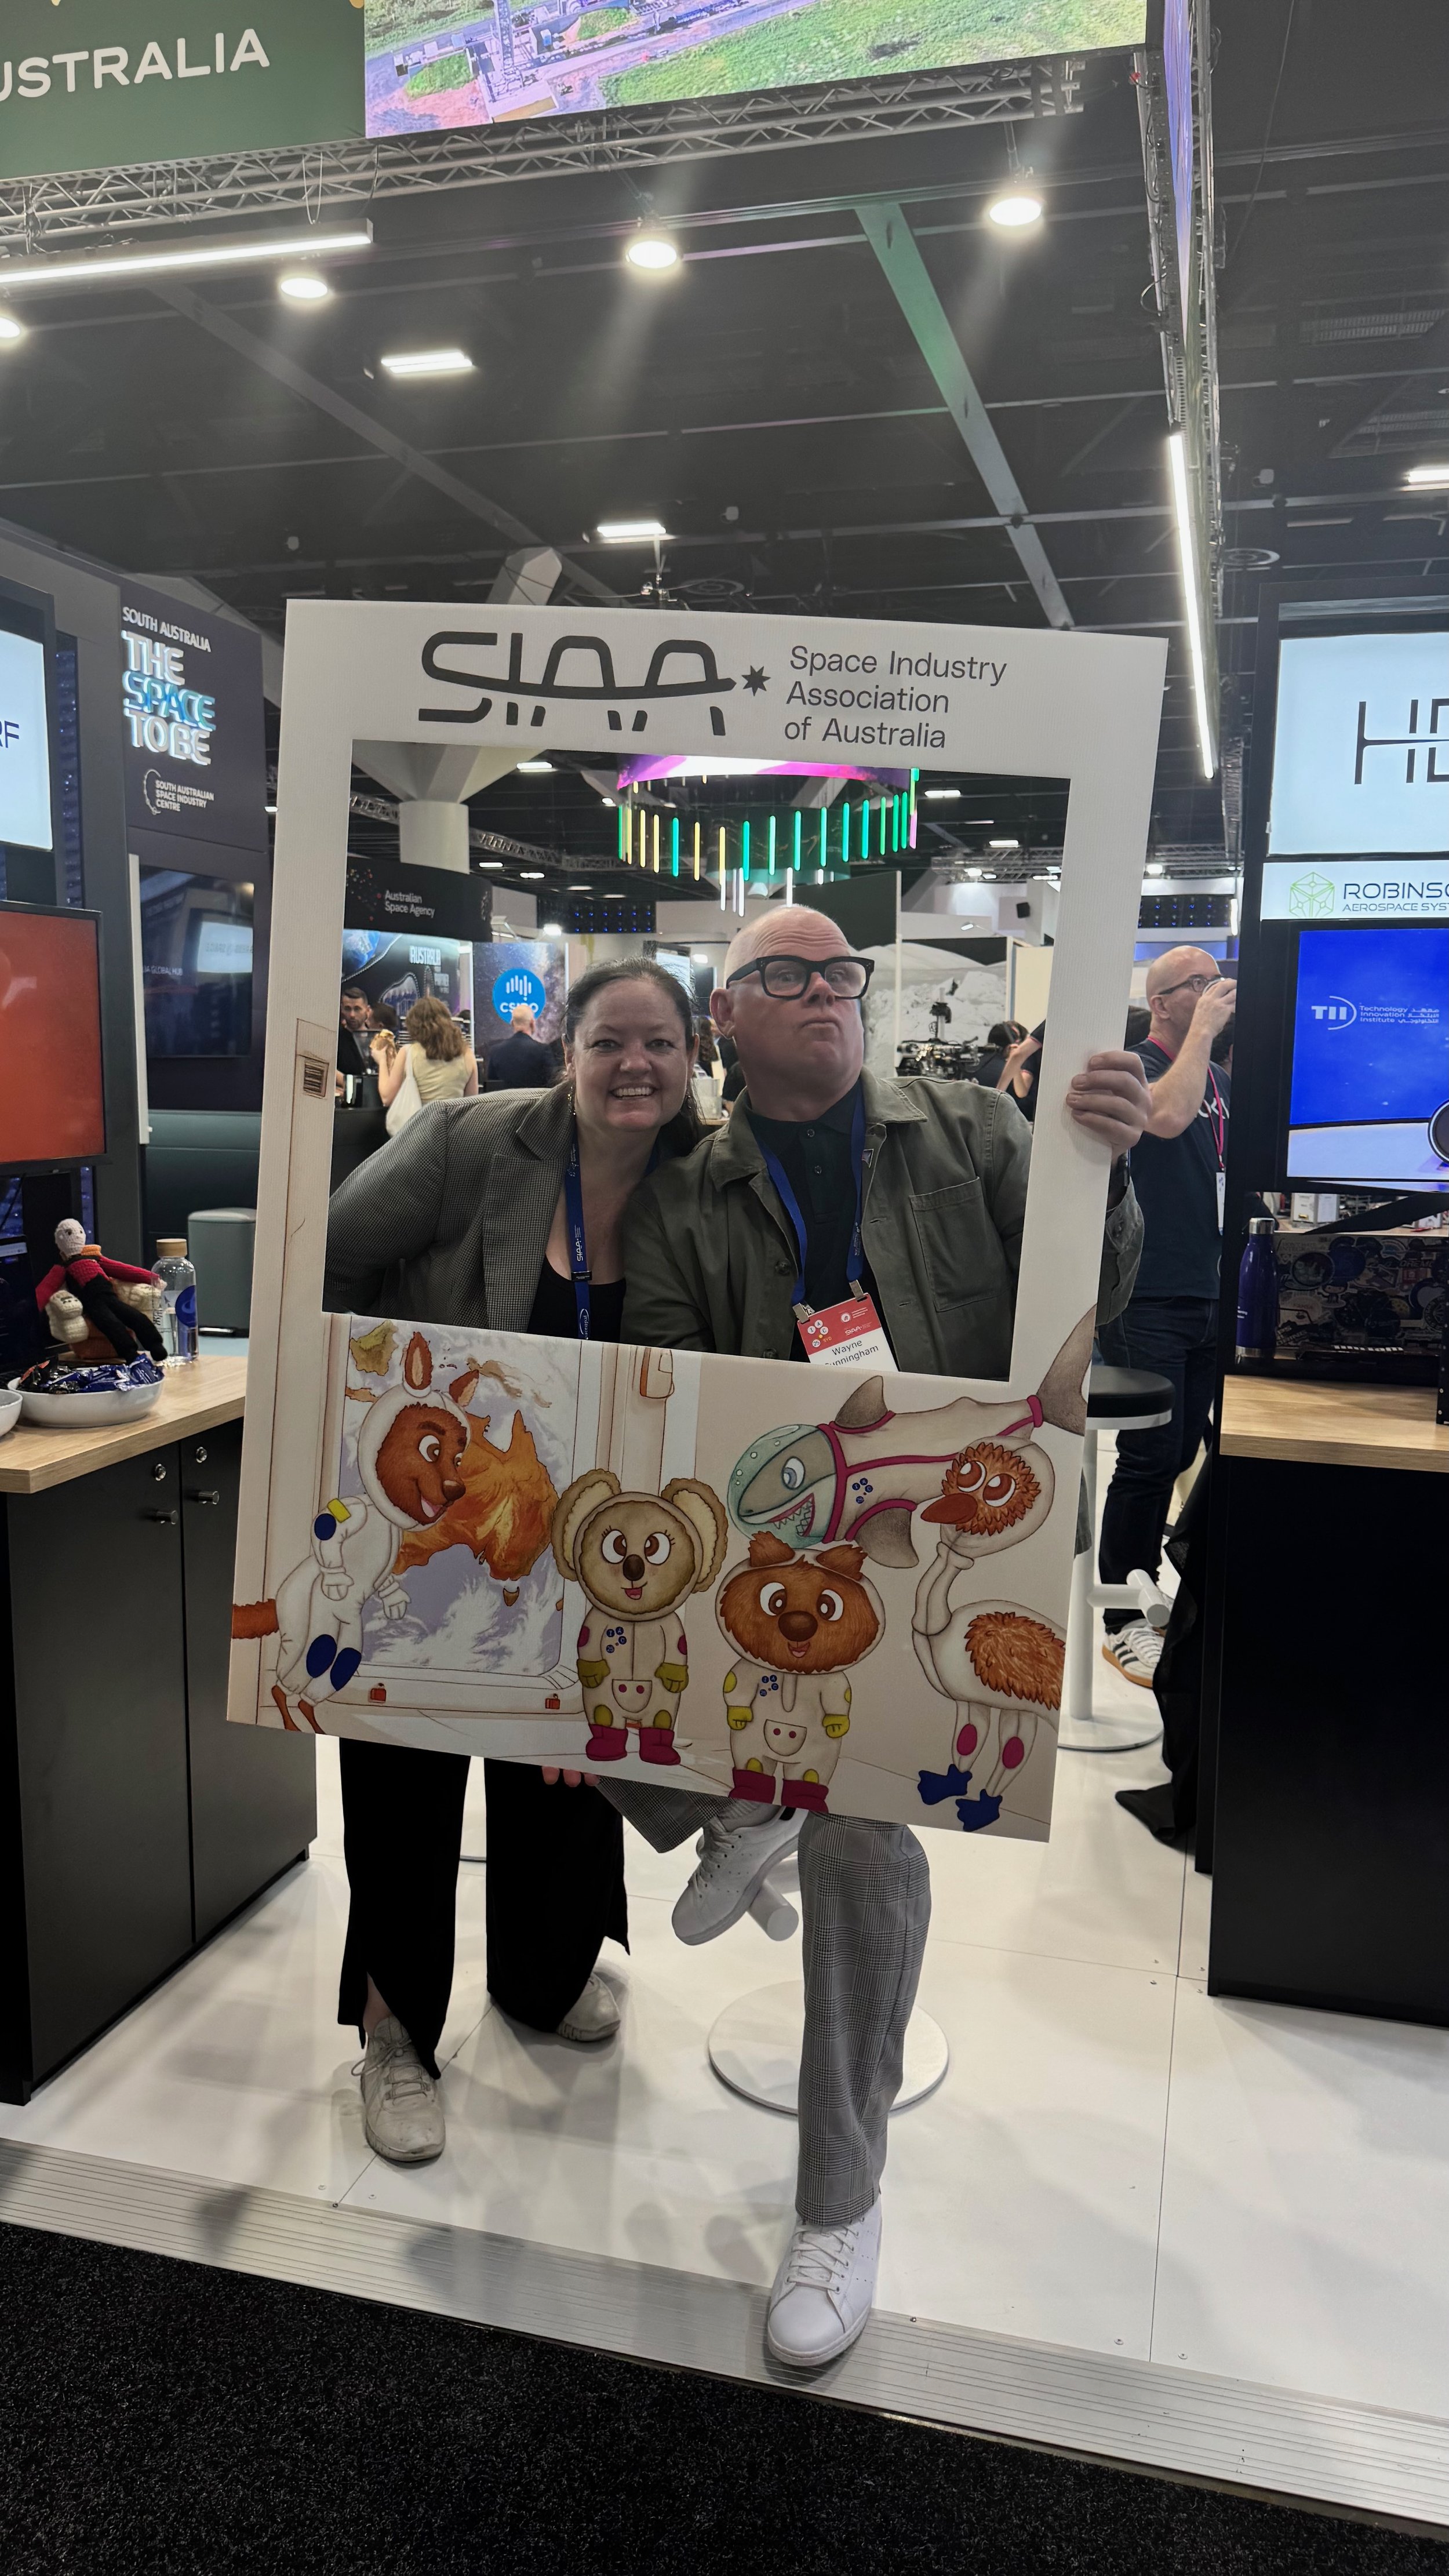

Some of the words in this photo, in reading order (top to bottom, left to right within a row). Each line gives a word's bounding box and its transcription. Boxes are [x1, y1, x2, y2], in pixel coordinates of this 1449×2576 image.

[122, 606, 158, 632] SOUTH
[159, 621, 211, 652] AUSTRALIA
[121, 630, 185, 686] THE
[790, 645, 877, 676] Space
[890, 650, 1007, 687] Industry
[122, 671, 216, 732] SPACE
[786, 681, 949, 713] Association
[784, 716, 812, 740] of
[822, 718, 946, 748] Australia
[155, 780, 176, 792] SOUTH
[177, 785, 214, 801] AUSTRALIAN
[155, 789, 176, 802] SPACE
[177, 795, 207, 809] INDUSTRY
[156, 800, 181, 812] CENTRE
[385, 889, 423, 904] Australian
[1343, 882, 1449, 900] ROBINS
[385, 901, 409, 914] Space
[410, 904, 435, 918] Agency
[1342, 903, 1418, 912] AEROSPACE
[409, 945, 441, 966] AUSTRALIA
[500, 1002, 539, 1013] CSO
[1311, 1006, 1347, 1020] TII
[825, 1345, 879, 1366] nningham
[832, 1340, 862, 1355] Wayne
